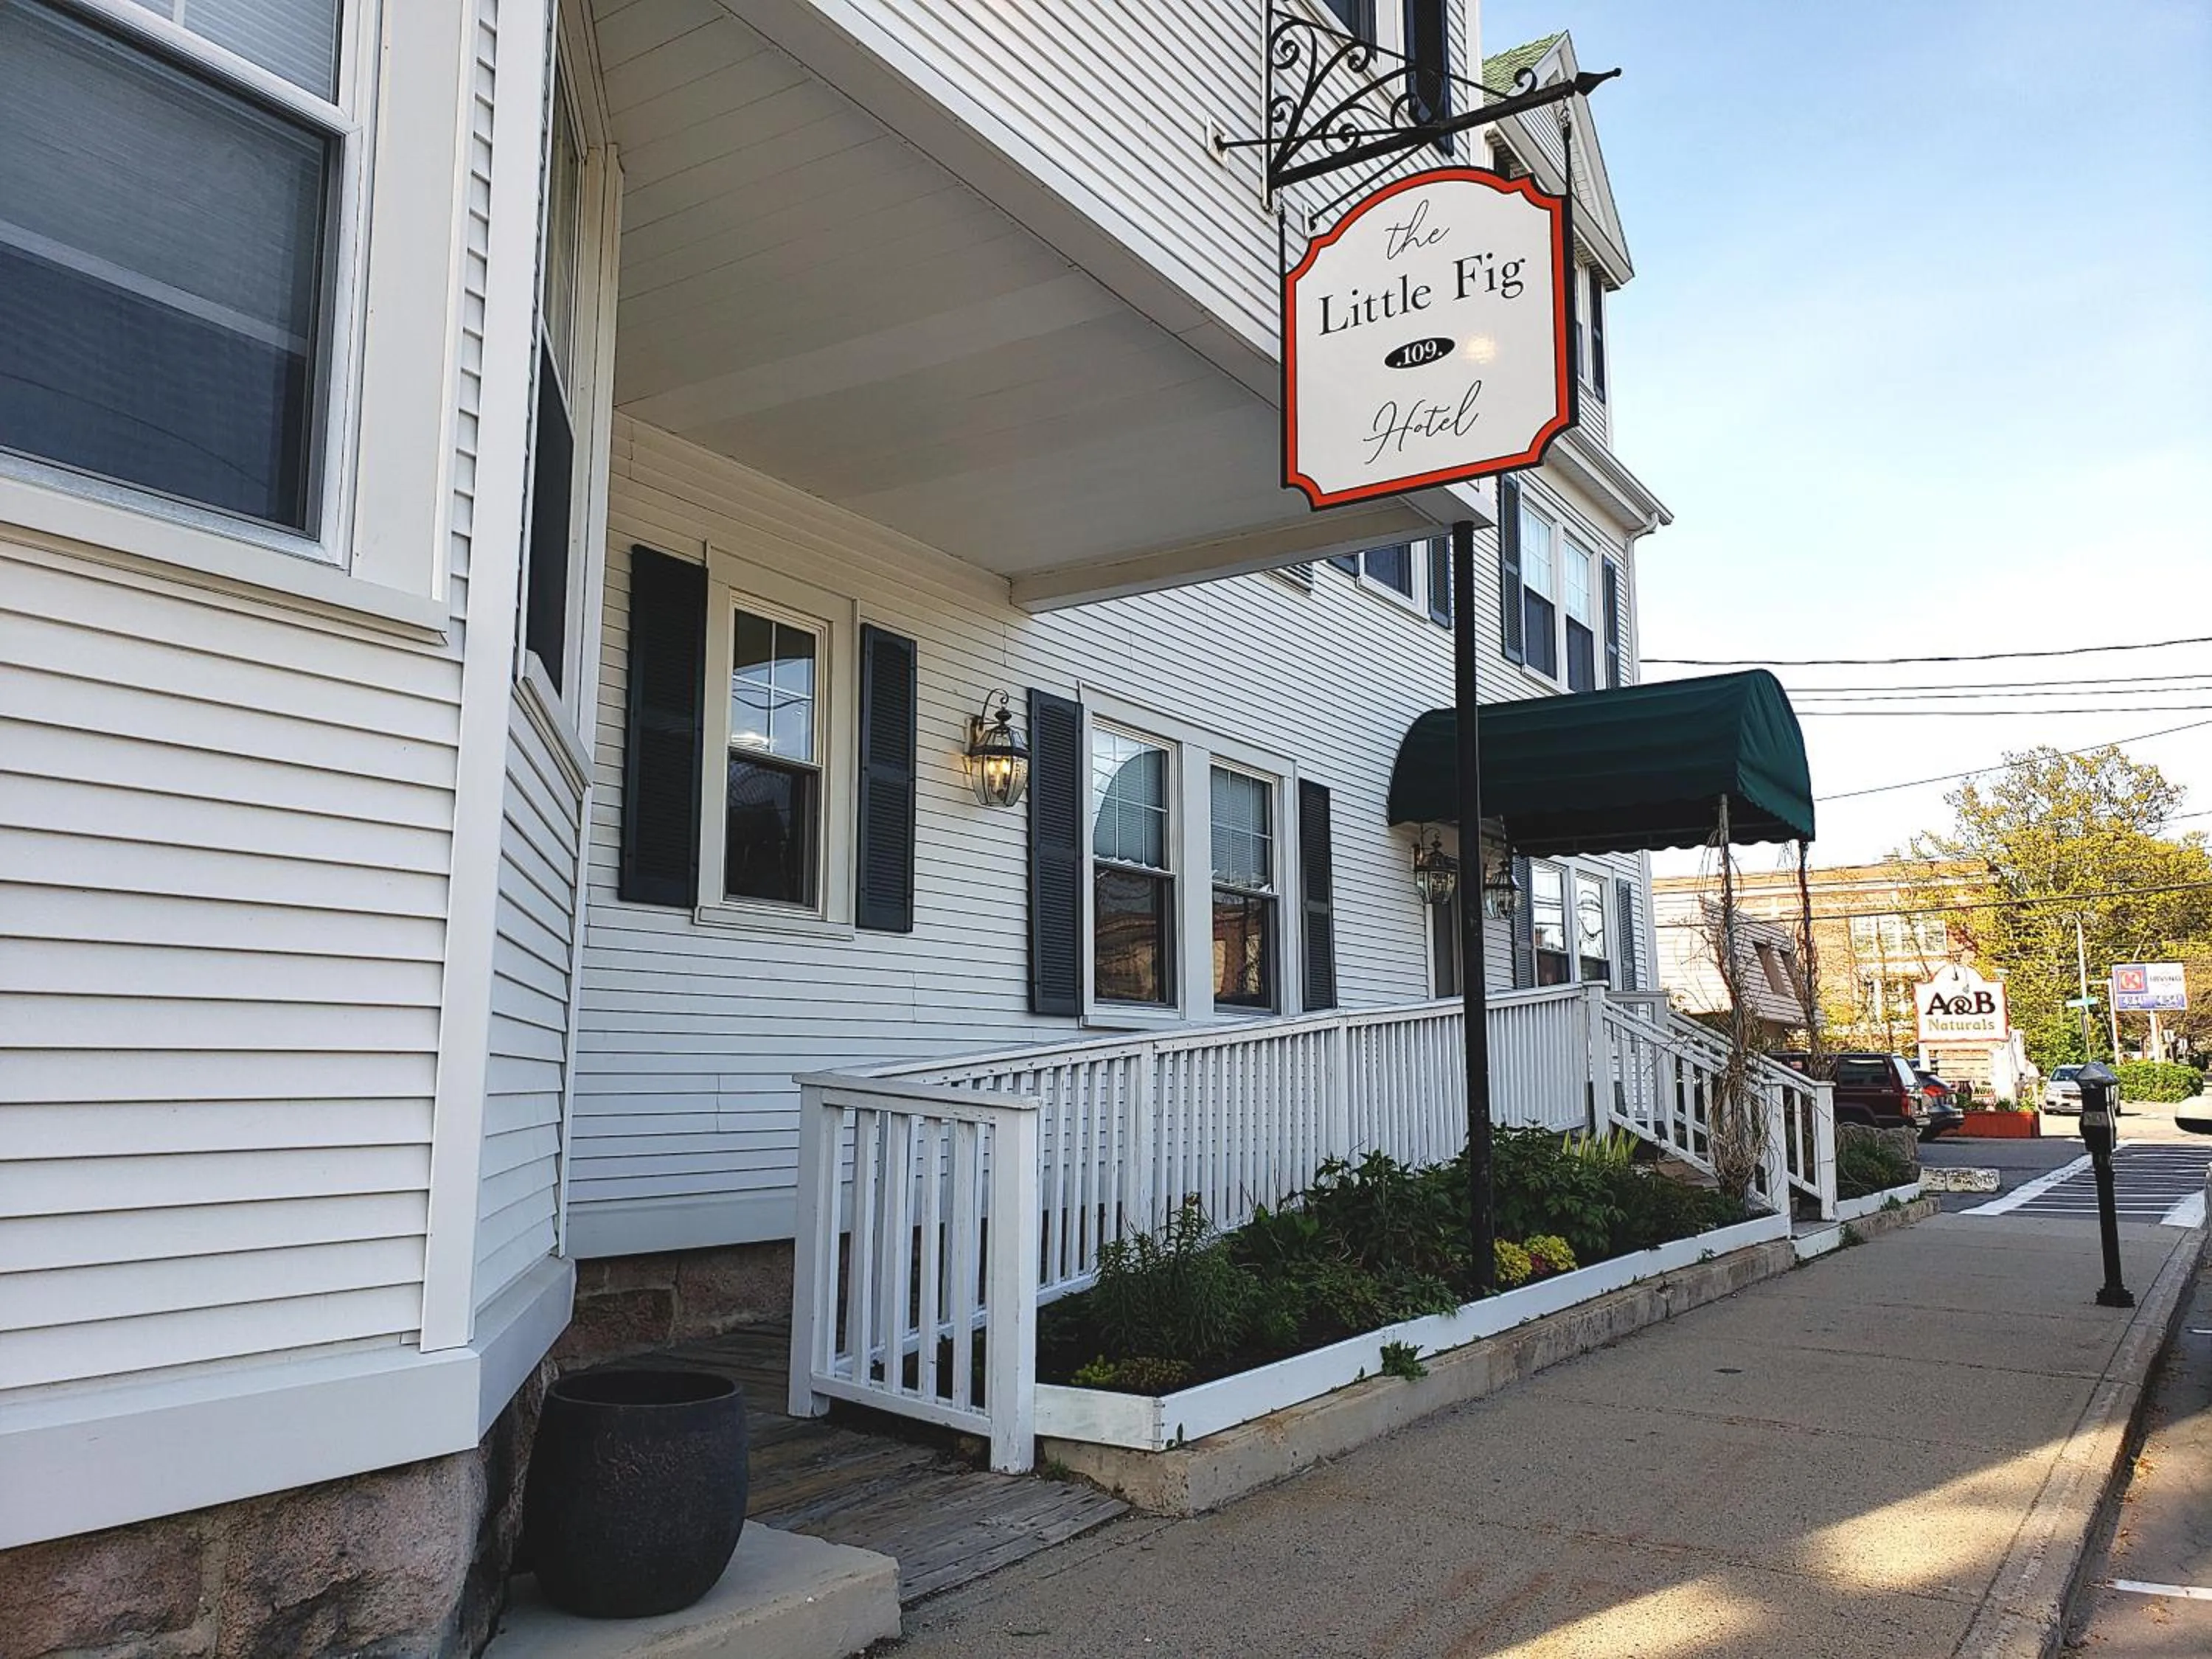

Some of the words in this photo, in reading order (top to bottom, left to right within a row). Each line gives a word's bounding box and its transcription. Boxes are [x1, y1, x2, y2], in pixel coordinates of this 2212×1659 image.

[1385, 198, 1450, 260] the
[1318, 274, 1432, 336] Little
[1452, 251, 1526, 299] Fig
[1363, 380, 1482, 465] Hotel
[1924, 990, 1996, 1015] A&B
[1927, 1018, 1995, 1032] Naturals
